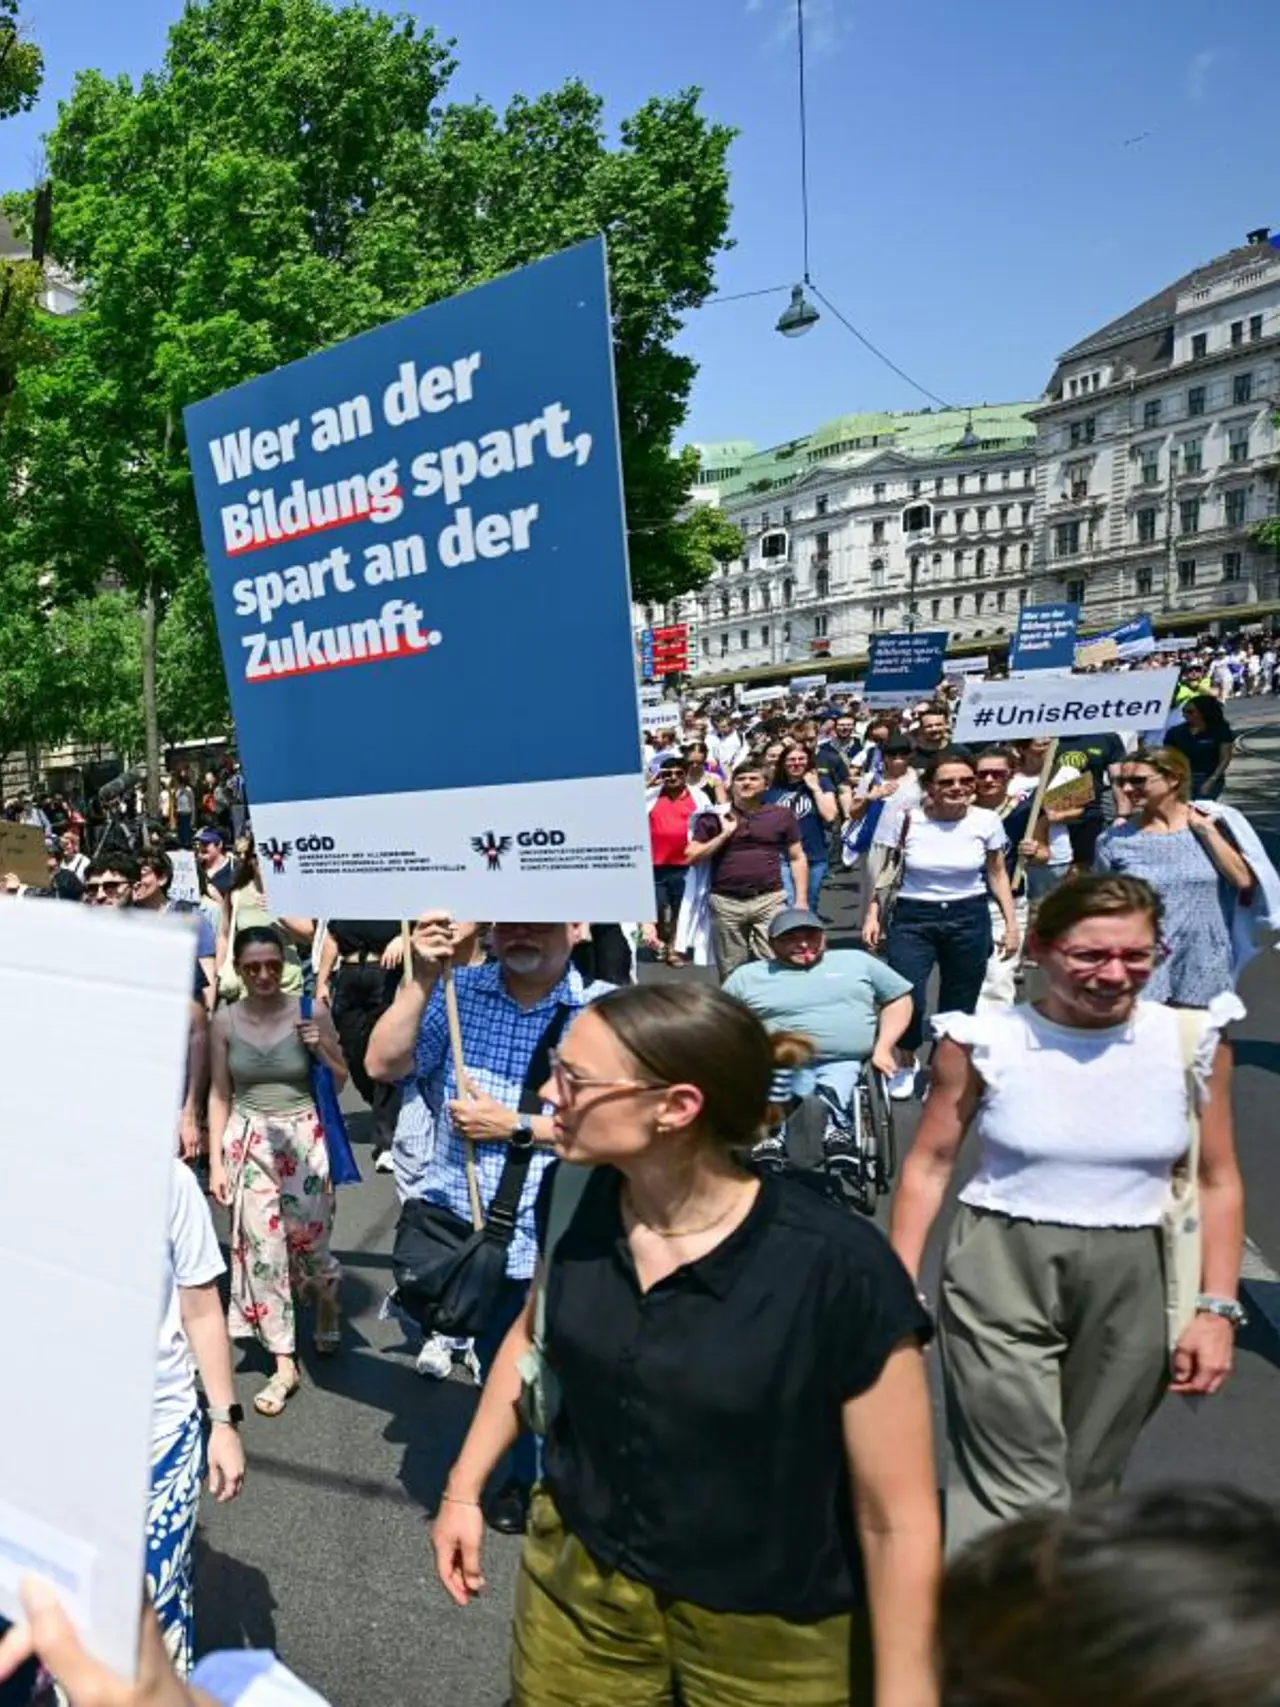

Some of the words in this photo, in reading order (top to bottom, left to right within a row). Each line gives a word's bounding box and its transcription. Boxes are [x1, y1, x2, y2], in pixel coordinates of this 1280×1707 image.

[209, 420, 300, 485] Wer
[311, 395, 373, 453] an
[384, 352, 482, 426] der
[221, 459, 403, 552] Bildung
[411, 402, 593, 504] spart,
[232, 547, 355, 623] spart
[364, 532, 427, 587] an
[438, 503, 540, 568] der
[241, 599, 442, 680] Zukunft.
[973, 699, 1162, 727] #UnisRetten
[295, 834, 335, 852] GÖD
[517, 828, 565, 847] GÖD
